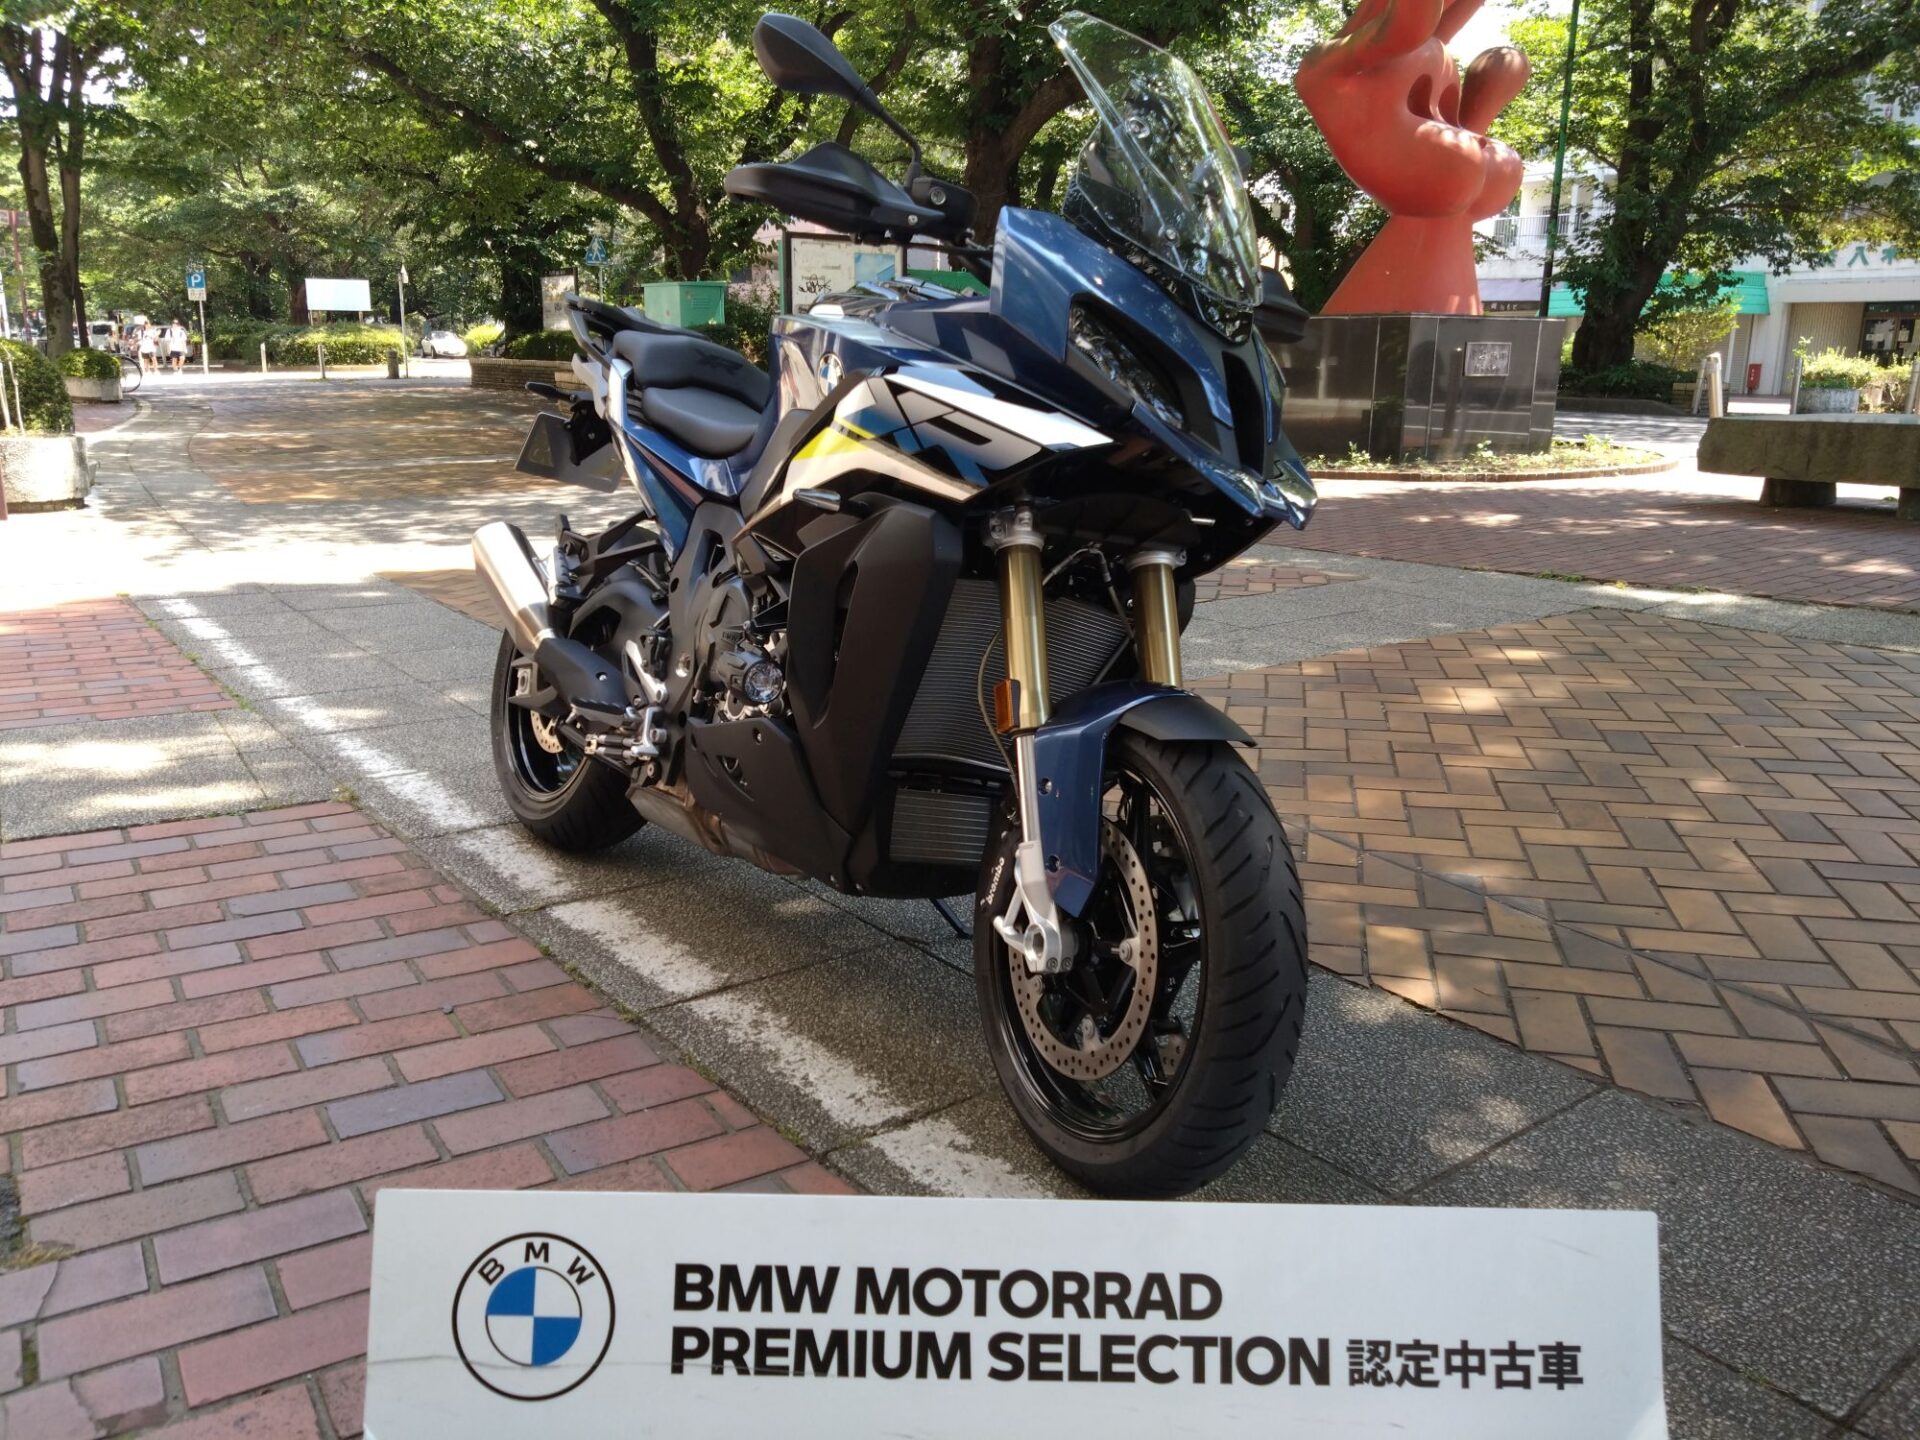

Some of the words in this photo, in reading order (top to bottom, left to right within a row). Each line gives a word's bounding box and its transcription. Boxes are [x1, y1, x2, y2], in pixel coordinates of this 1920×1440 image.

[191, 274, 201, 287] P
[986, 857, 1005, 904] brembo
[477, 1241, 596, 1286] BMW
[674, 1263, 840, 1314] BMW
[854, 1266, 1223, 1321] MOTORRAD
[670, 1326, 972, 1380] PREMIUM
[987, 1331, 1330, 1386] SELECTION
[1346, 1338, 1584, 1391] 認定中古車
